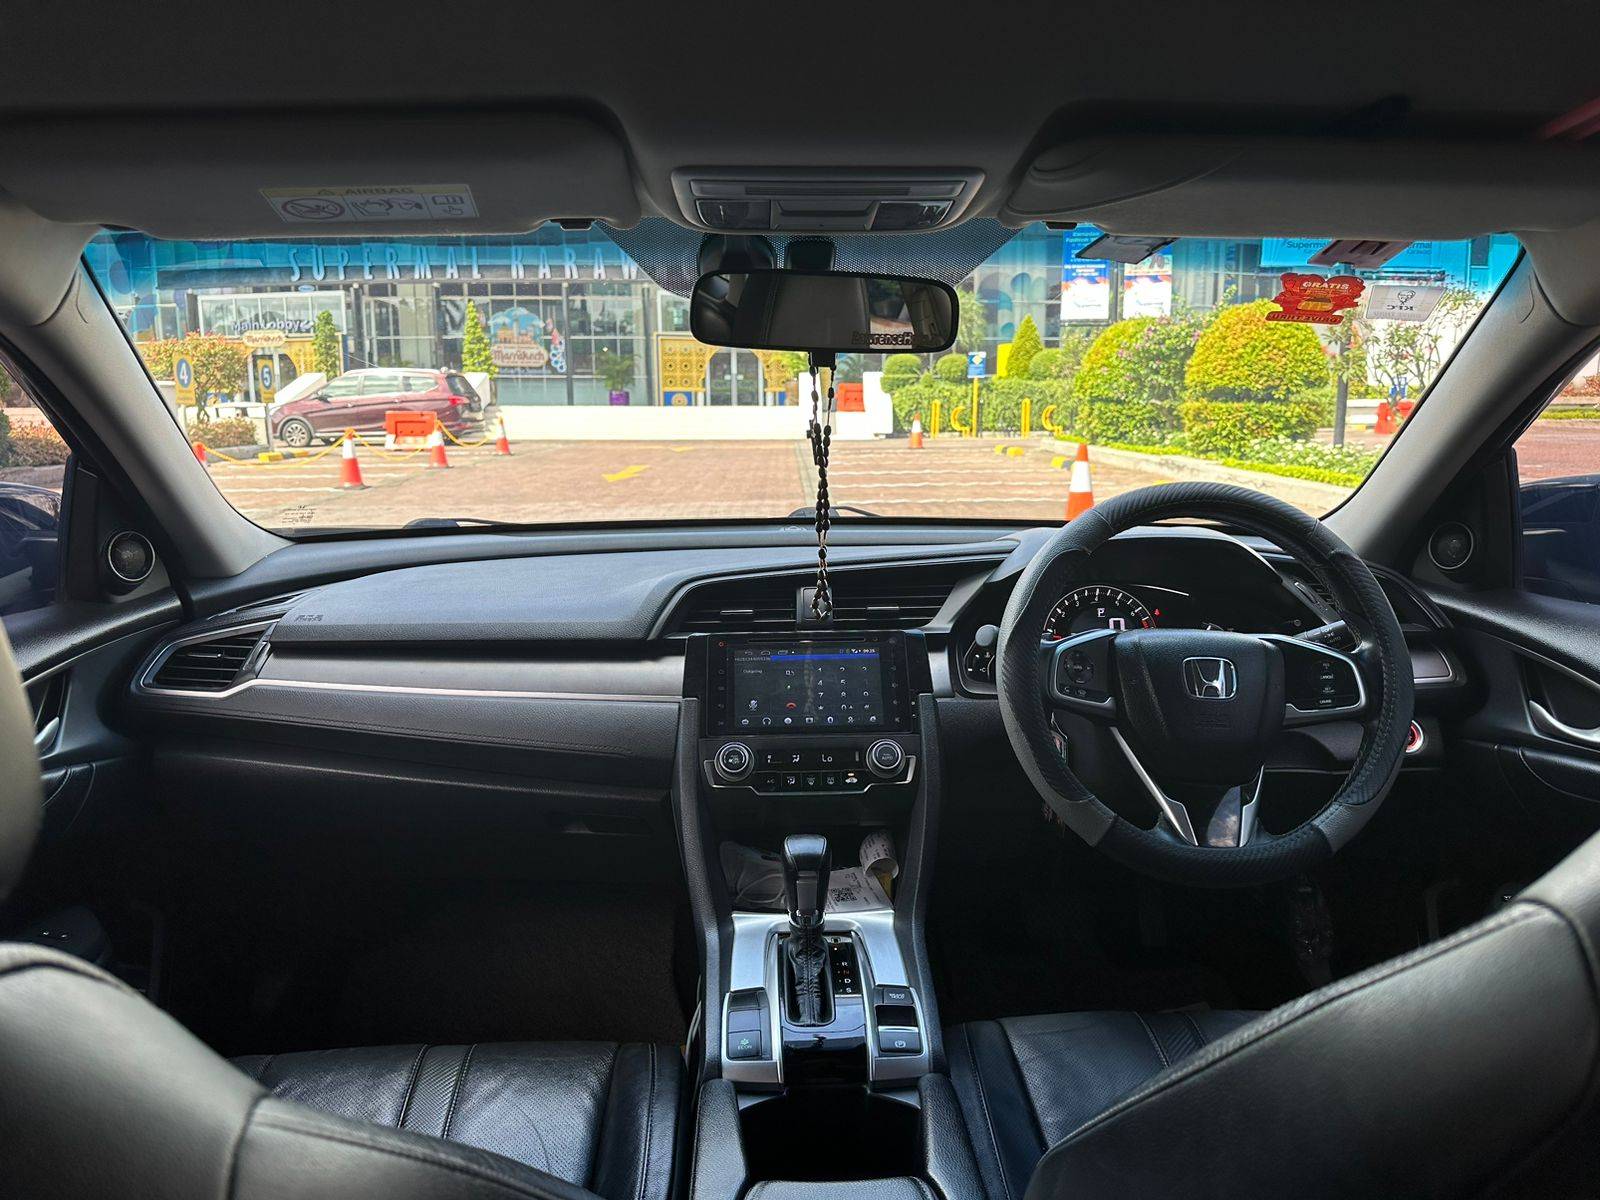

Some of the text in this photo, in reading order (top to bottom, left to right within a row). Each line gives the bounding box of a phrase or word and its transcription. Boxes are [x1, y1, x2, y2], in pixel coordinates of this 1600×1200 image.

[345, 187, 415, 196] AIRBAG
[289, 245, 482, 281] SUPERMAL
[1303, 281, 1350, 290] GRATIS
[179, 362, 189, 384] 4
[263, 367, 271, 387] 5
[1096, 607, 1106, 618] P
[821, 754, 833, 763] Lo
